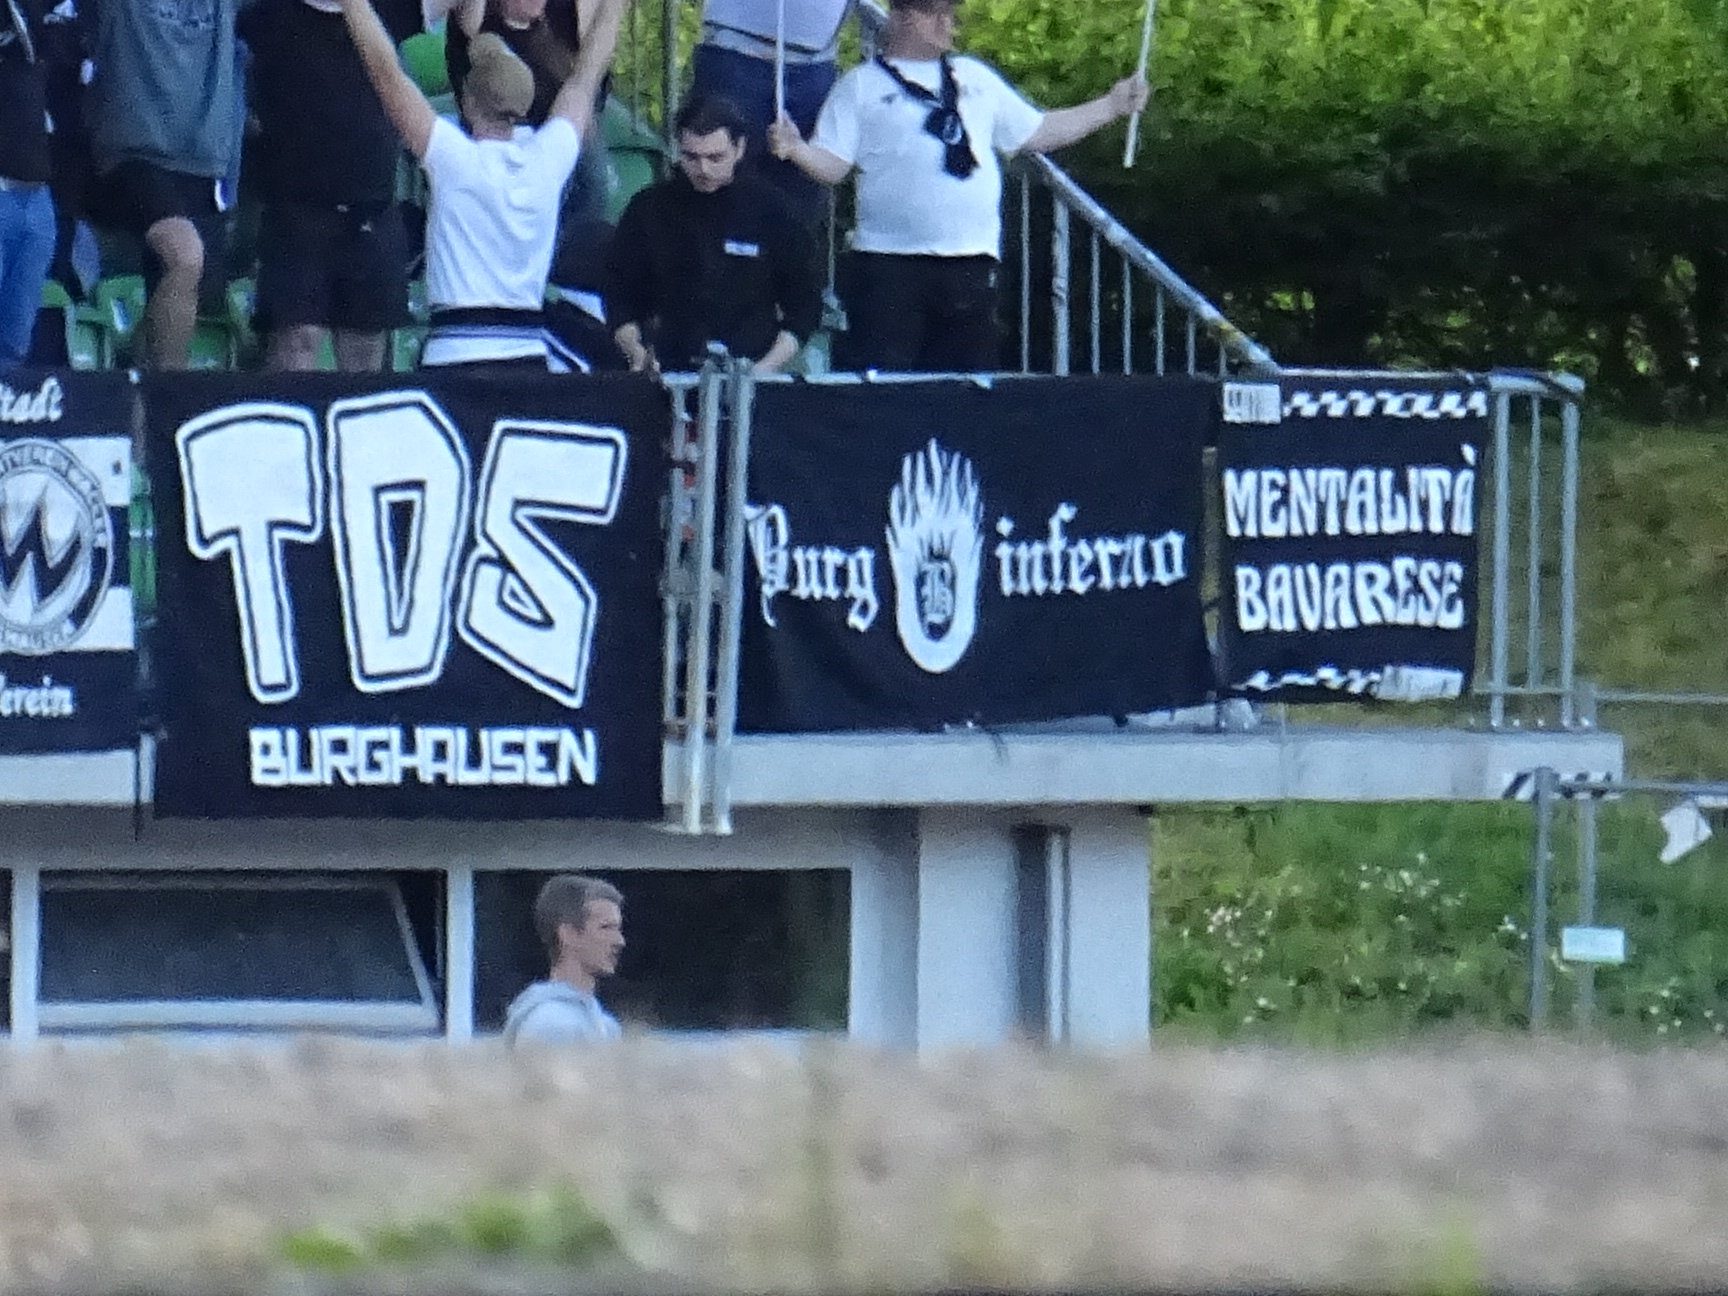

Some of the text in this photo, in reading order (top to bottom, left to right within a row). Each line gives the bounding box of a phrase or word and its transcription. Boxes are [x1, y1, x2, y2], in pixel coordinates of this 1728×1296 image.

[174, 387, 628, 709] TDS
[744, 501, 1187, 632] Burg inferno
[1235, 555, 1465, 633] BAVARESE
[248, 725, 597, 786] BURGHAUSEN
